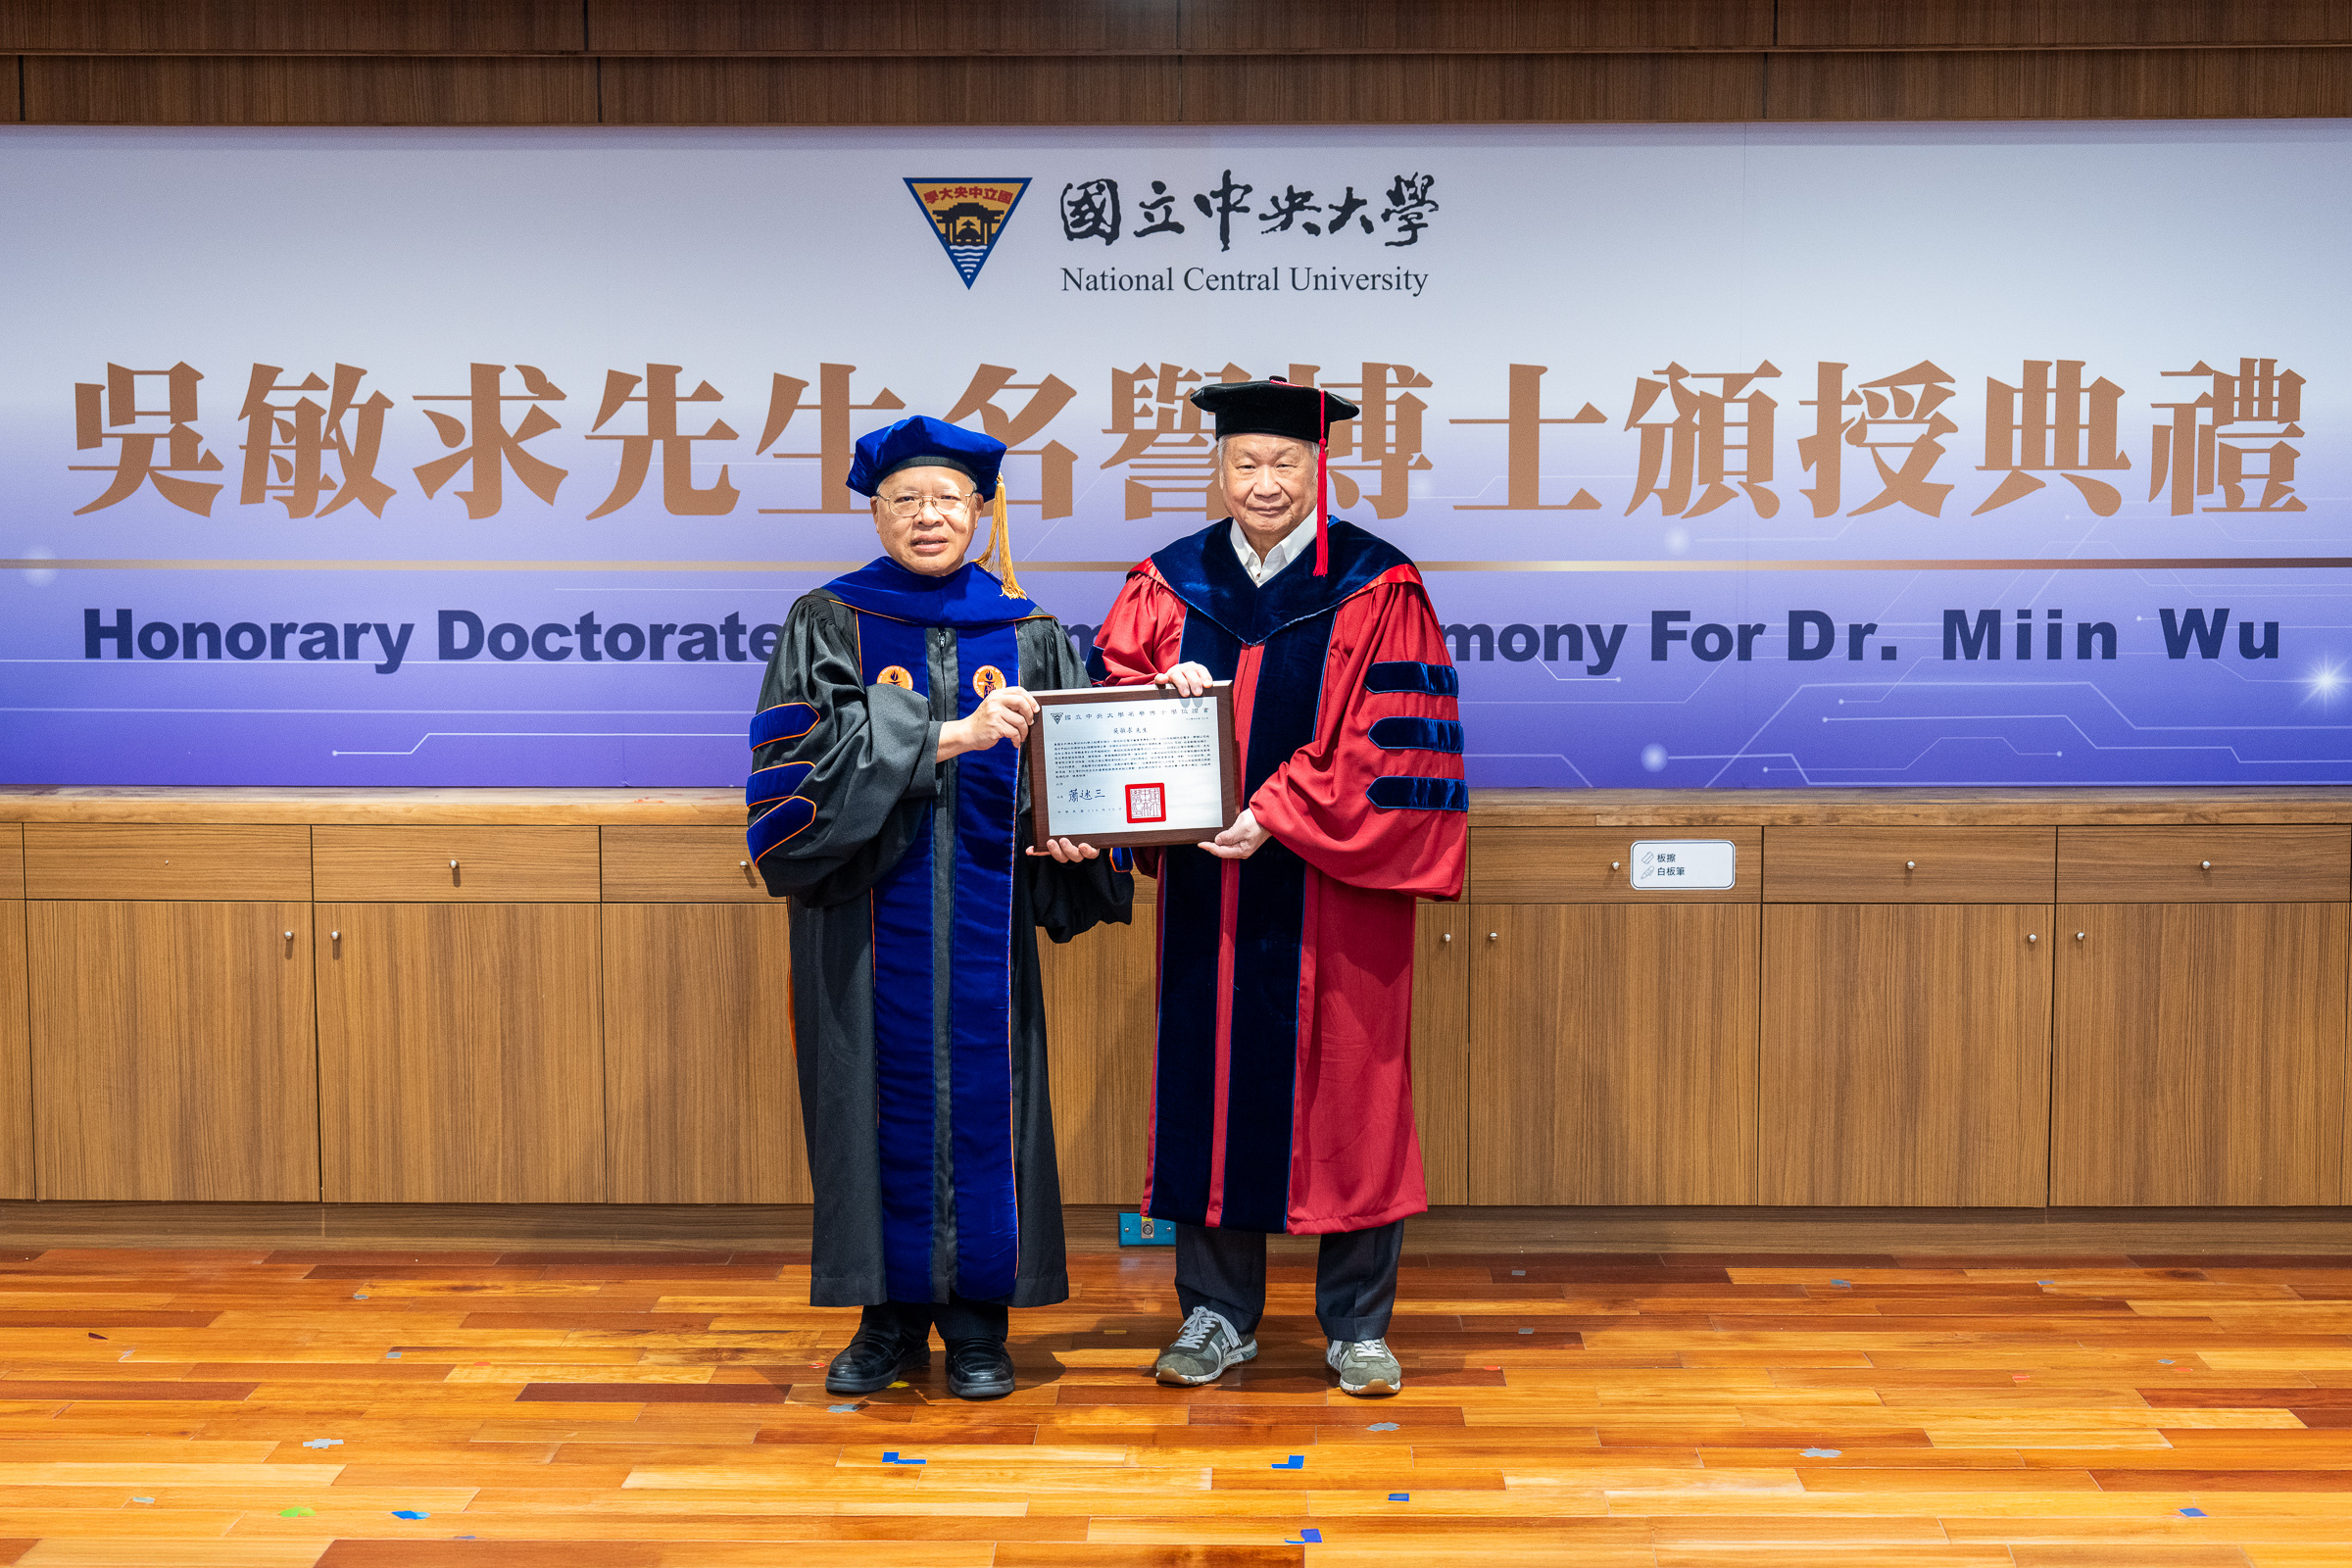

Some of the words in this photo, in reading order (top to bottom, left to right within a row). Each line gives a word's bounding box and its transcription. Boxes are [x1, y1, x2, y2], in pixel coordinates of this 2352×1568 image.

[1060, 170, 1439, 252] 國立中央大學
[1062, 268, 1173, 291] National
[1184, 268, 1278, 291] Central
[1291, 267, 1429, 296] University
[84, 609, 414, 674] Honorary
[439, 610, 783, 662] Doctorate
[1651, 610, 1766, 661] For
[1788, 610, 1897, 661] Dr.
[1942, 609, 2117, 660] Miin
[2160, 609, 2279, 659] Wu
[1656, 853, 1676, 863] 板擦
[1657, 866, 1686, 876] 白板筆
